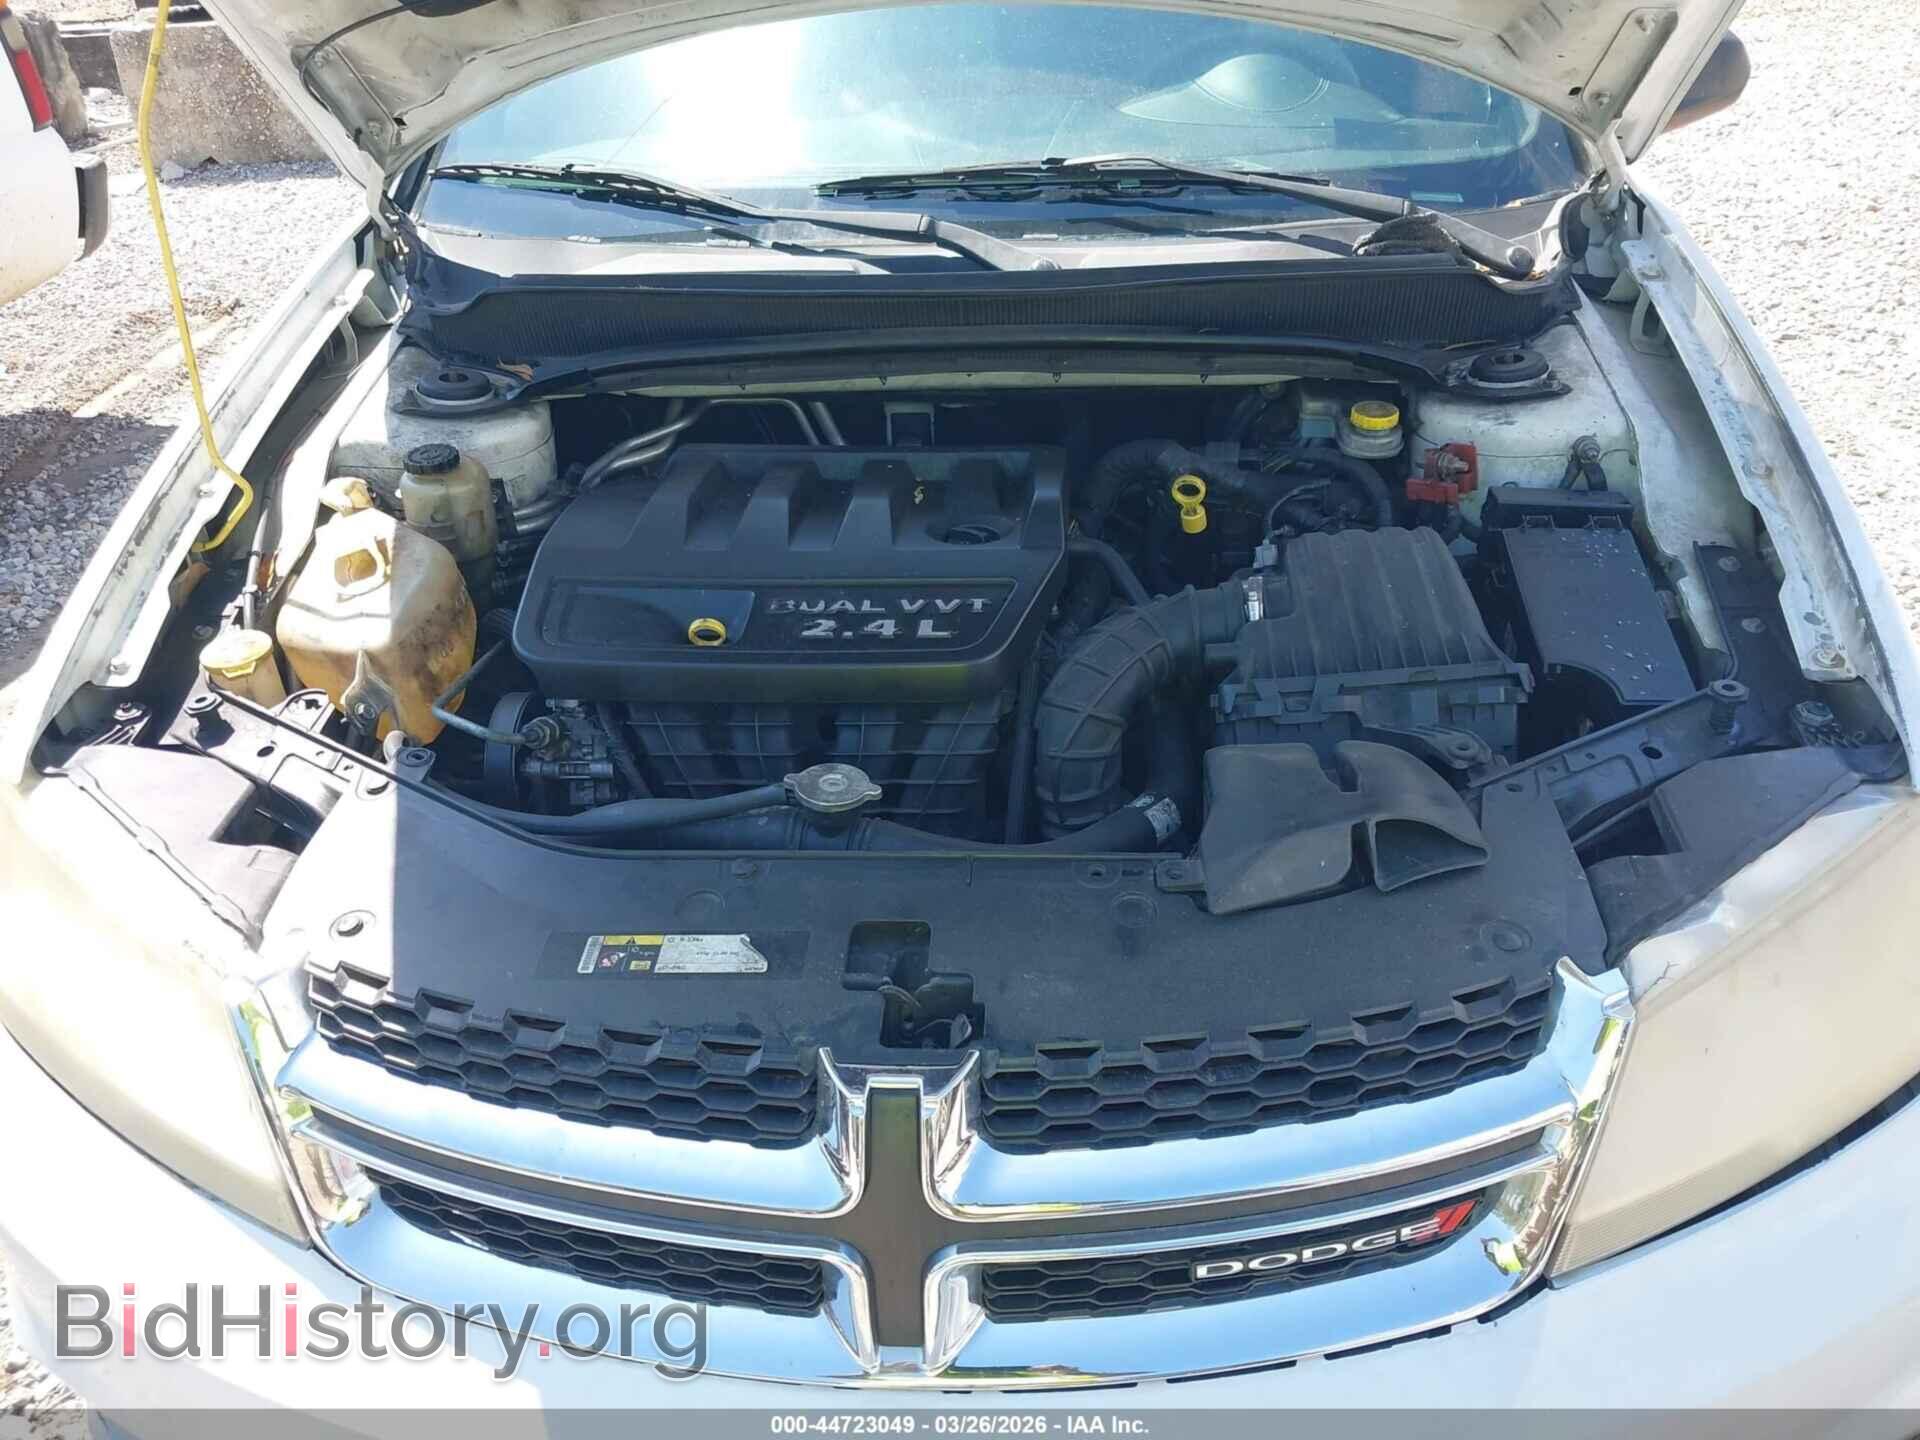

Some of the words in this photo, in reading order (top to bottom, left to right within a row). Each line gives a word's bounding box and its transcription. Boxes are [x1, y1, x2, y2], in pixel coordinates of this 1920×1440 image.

[768, 599, 886, 613] DUAL
[900, 598, 991, 613] VVT
[1196, 1217, 1441, 1279] DODGE
